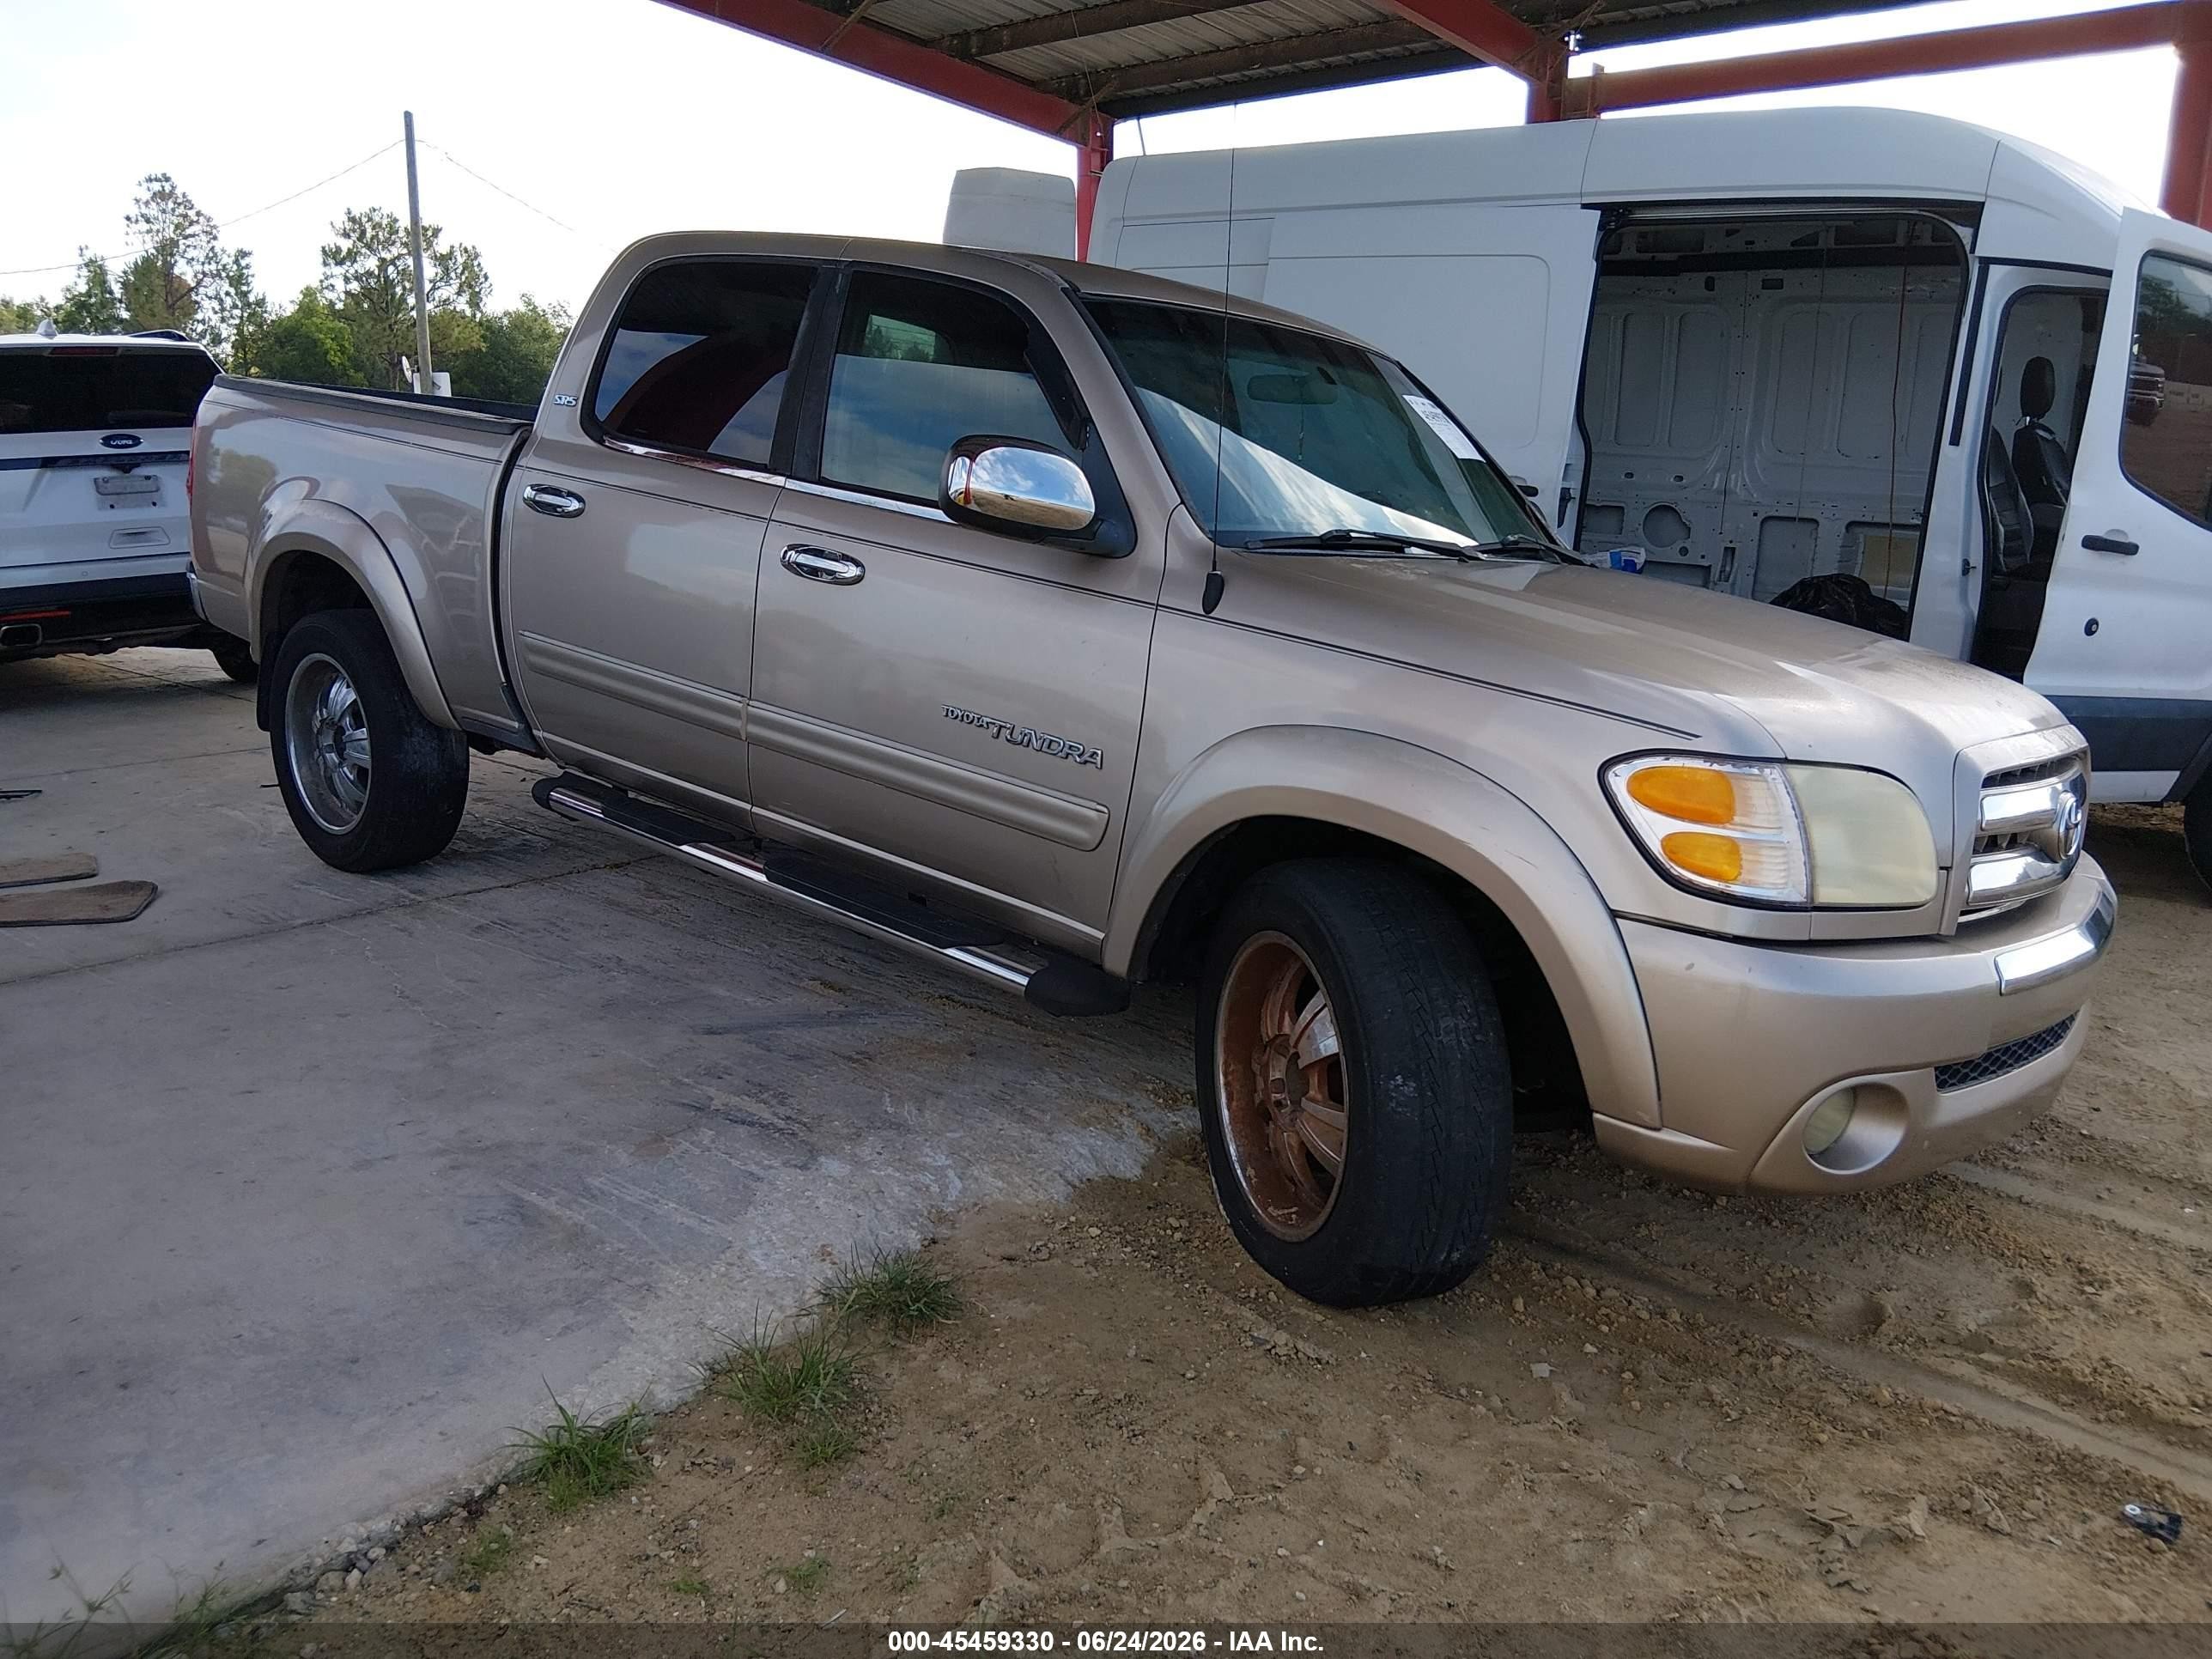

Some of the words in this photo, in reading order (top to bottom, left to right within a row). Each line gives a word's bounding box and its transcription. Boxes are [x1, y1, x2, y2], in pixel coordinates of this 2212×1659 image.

[553, 394, 578, 406] SR5
[941, 704, 989, 729] TOYOTA
[987, 718, 1103, 770] TUNDRA
